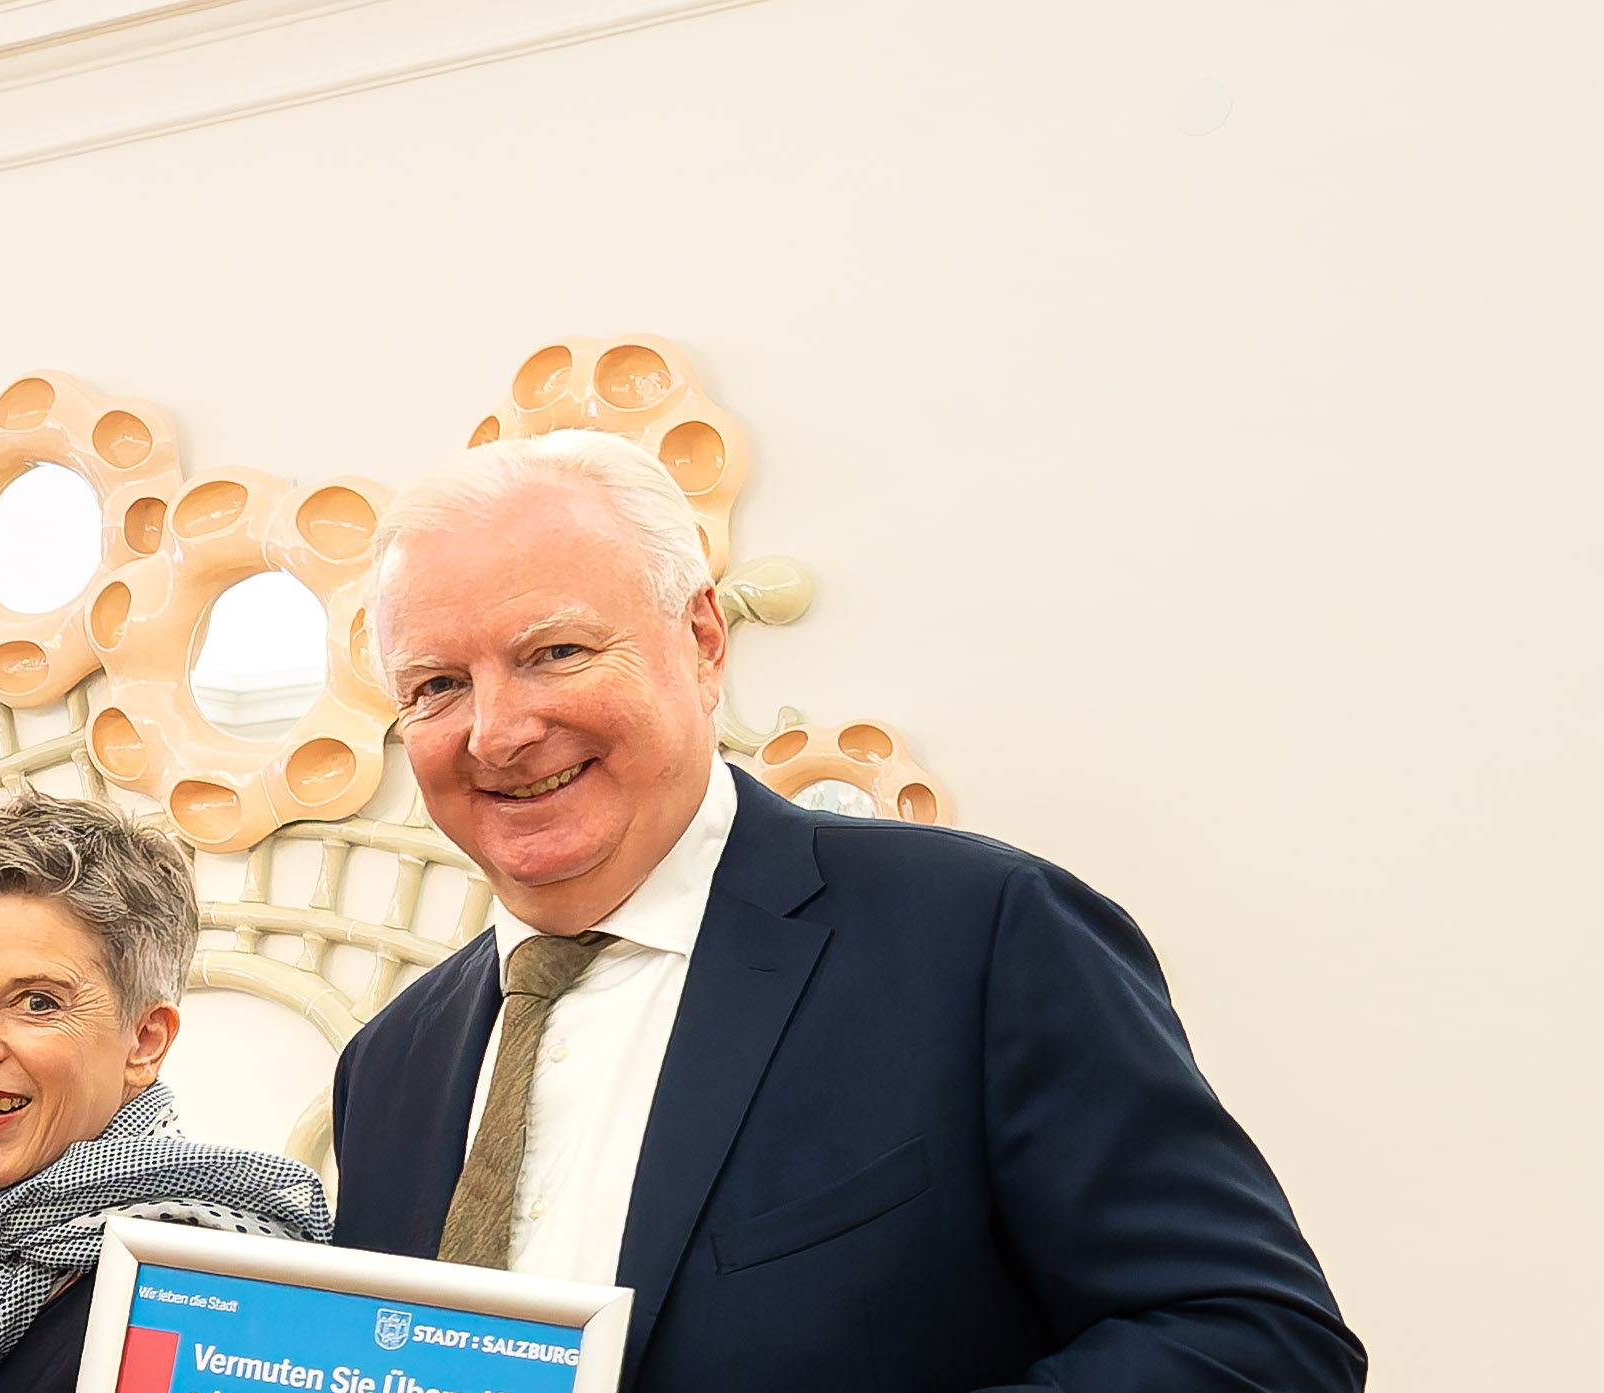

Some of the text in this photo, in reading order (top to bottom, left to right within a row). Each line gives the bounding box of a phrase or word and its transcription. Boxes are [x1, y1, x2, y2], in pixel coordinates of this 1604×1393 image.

[195, 1344, 324, 1390] Vermuten
[412, 1326, 470, 1348] STADT
[482, 1336, 579, 1367] SALZBURG
